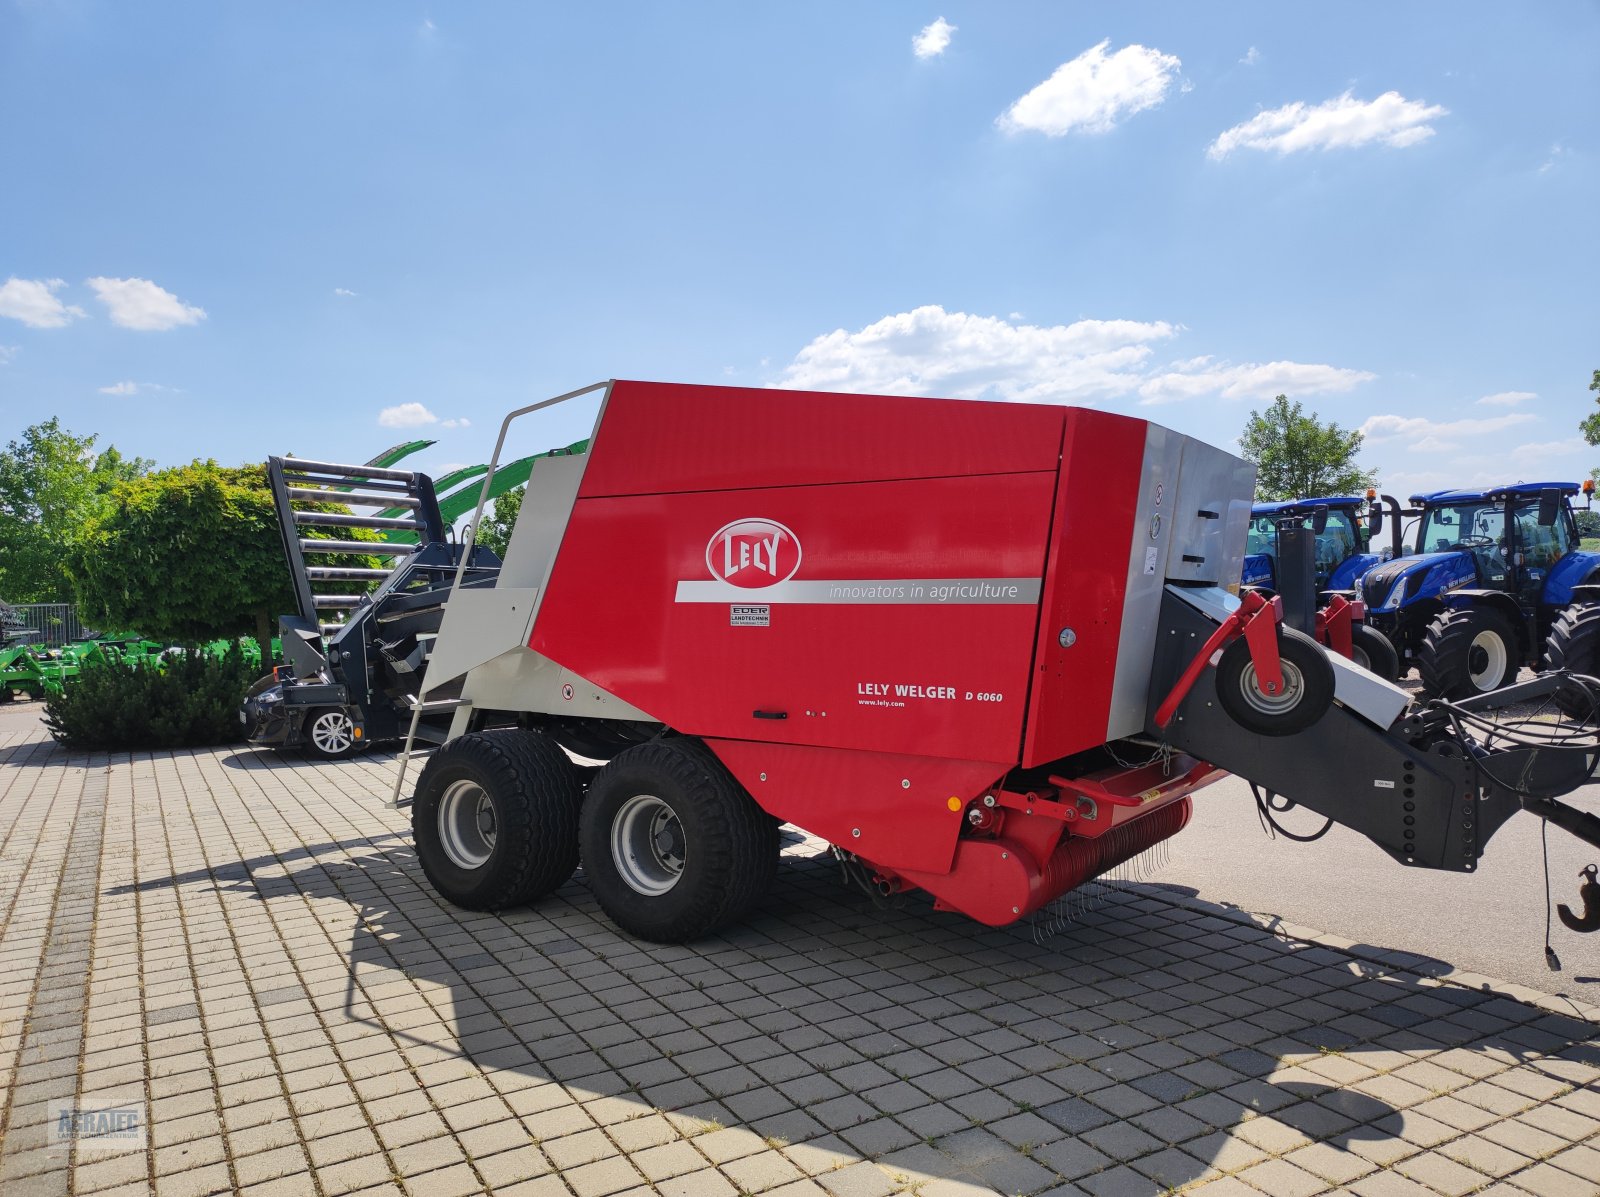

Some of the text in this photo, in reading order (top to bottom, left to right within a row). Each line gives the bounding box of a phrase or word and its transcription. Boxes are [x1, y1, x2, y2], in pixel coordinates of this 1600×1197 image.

[724, 531, 780, 578] LELY
[829, 582, 1018, 602] innovators in agriculture
[857, 682, 1003, 703] LELY WELGER D 6060
[858, 699, 905, 708] www.lely.com
